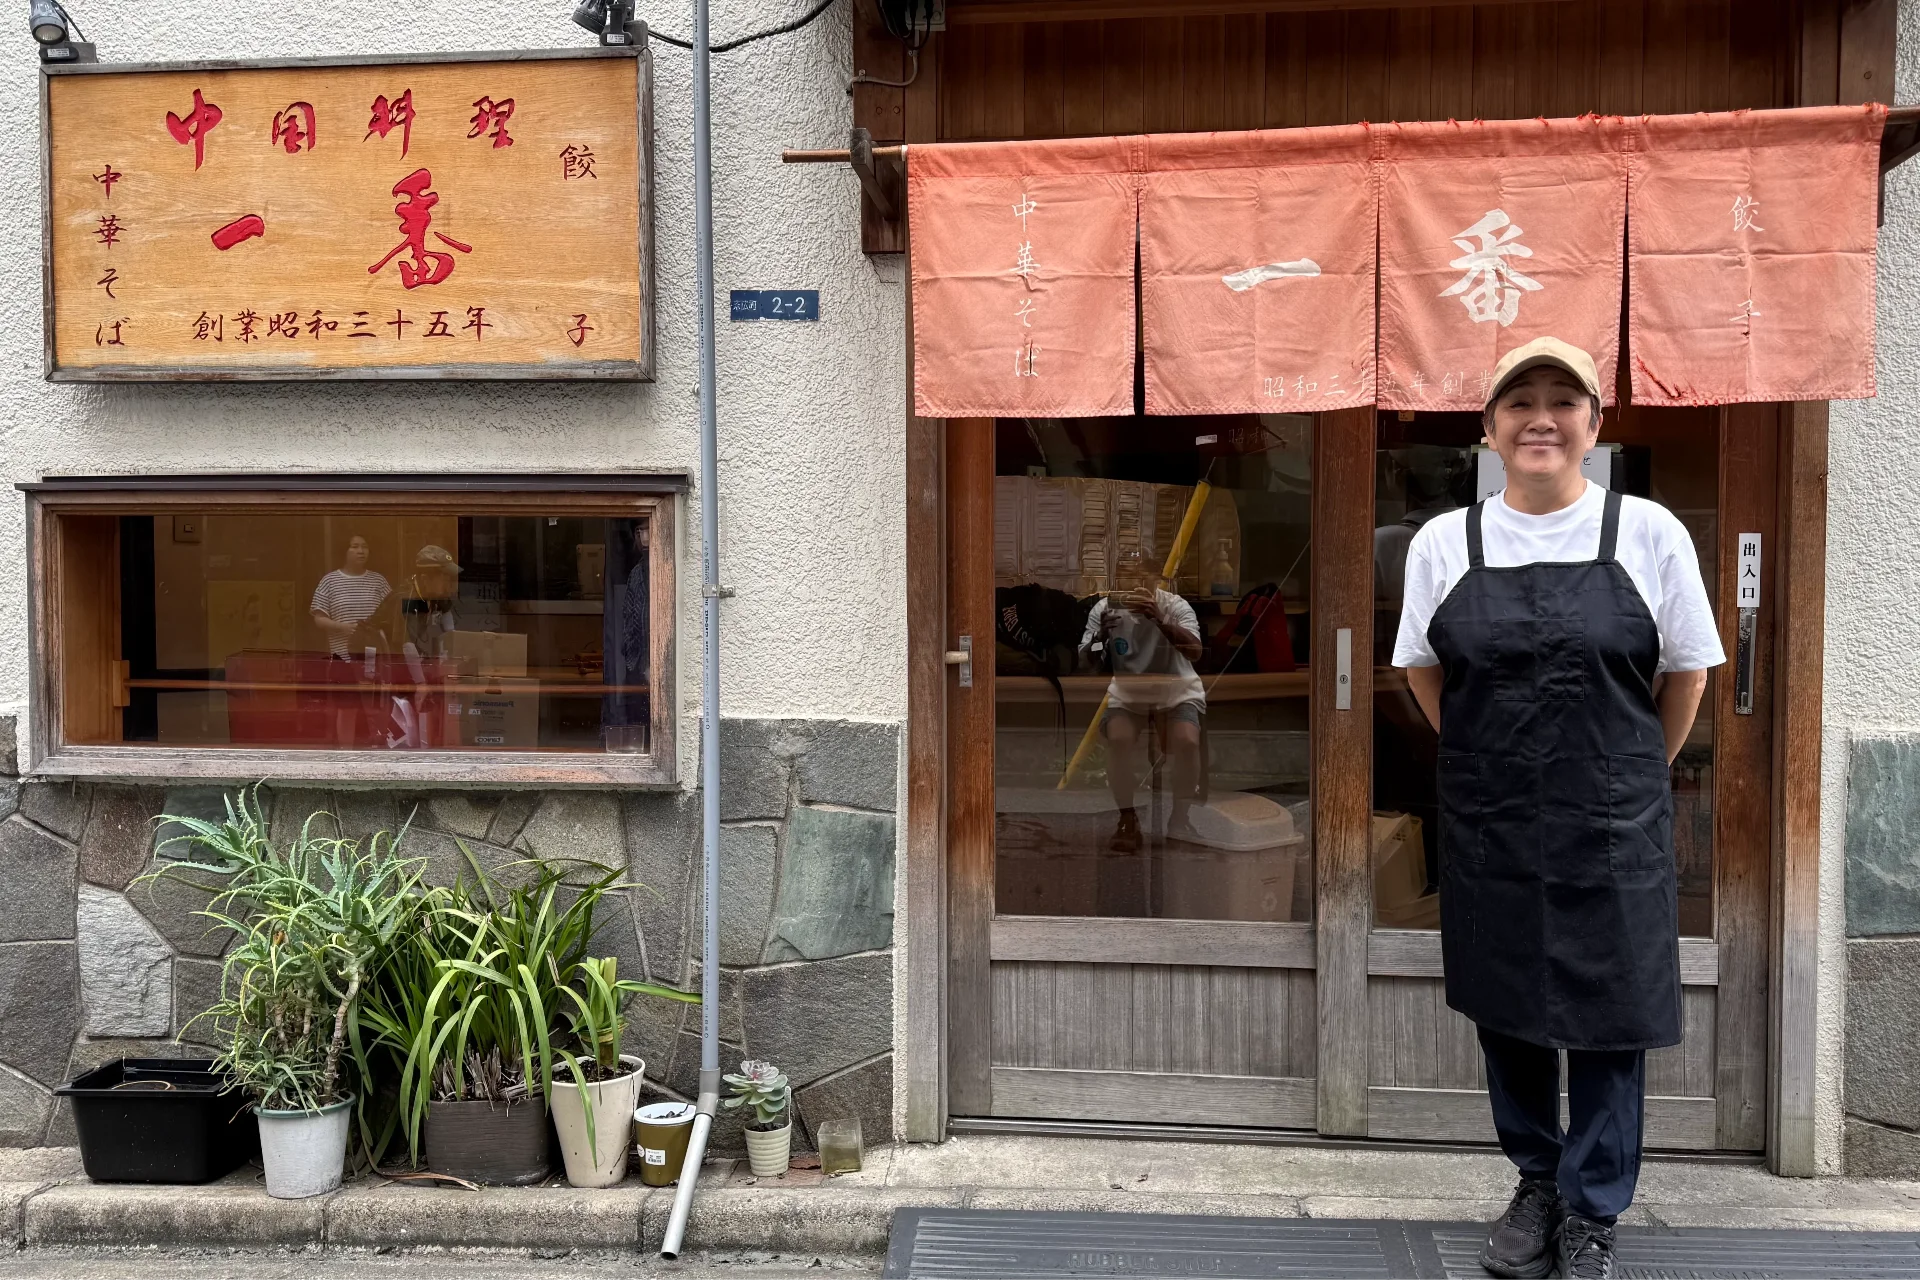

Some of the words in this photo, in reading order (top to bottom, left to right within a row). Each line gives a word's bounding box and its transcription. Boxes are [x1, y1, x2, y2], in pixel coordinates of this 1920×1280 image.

[166, 88, 516, 171] 中国料理
[91, 164, 128, 347] 中華そば
[210, 167, 473, 291] 一番
[1221, 208, 1545, 328] 一番
[192, 305, 494, 344] 創業昭和三十五年
[772, 296, 806, 314] 2-2
[1008, 193, 1043, 378] 中華そば
[1743, 542, 1757, 599] 出入口
[1068, 1252, 1159, 1270] RUBBER
[1166, 1256, 1224, 1272] STEP
